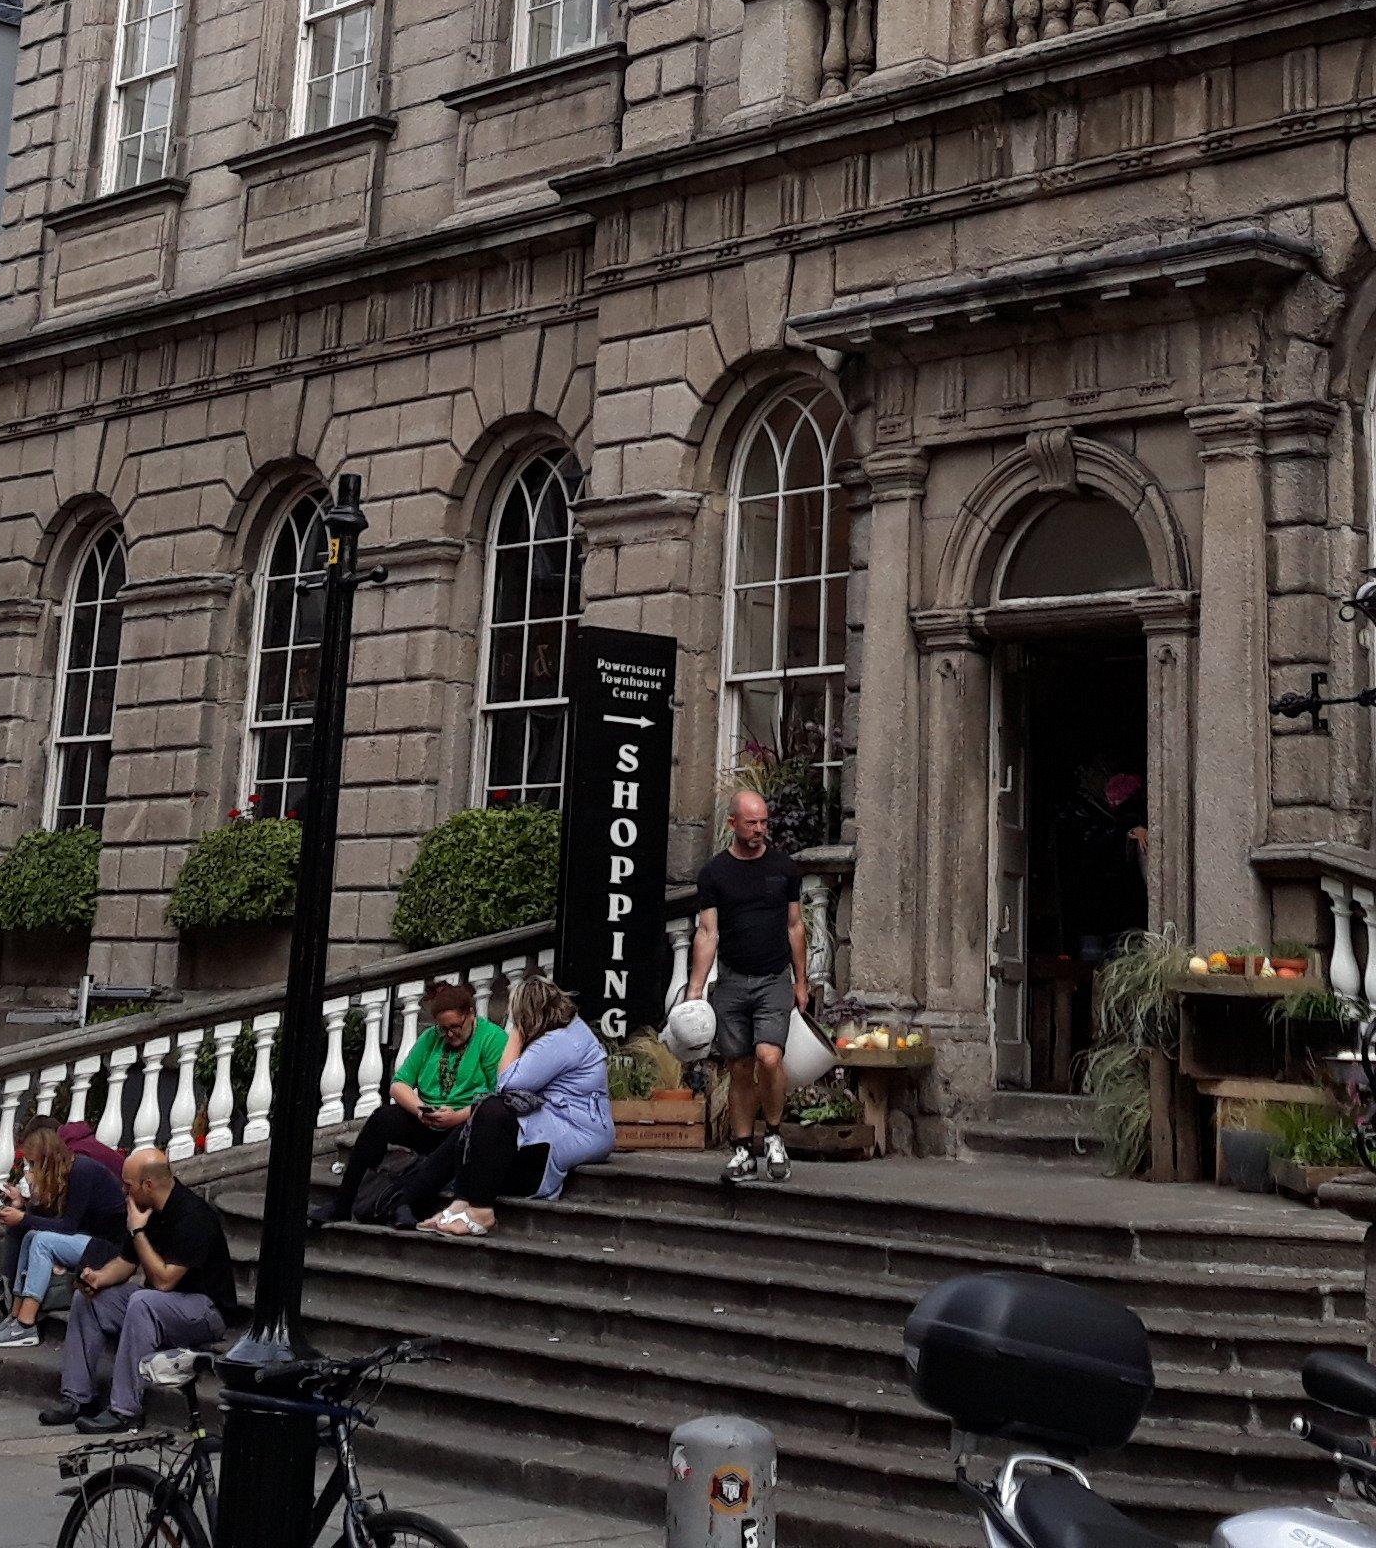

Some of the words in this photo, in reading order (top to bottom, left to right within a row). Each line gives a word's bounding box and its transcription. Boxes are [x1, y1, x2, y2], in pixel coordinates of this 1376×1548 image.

[596, 657, 666, 678] Powerscourt
[600, 671, 662, 690] Townhouse
[612, 686, 649, 702] Centre
[600, 743, 640, 1038] SHOPPING
